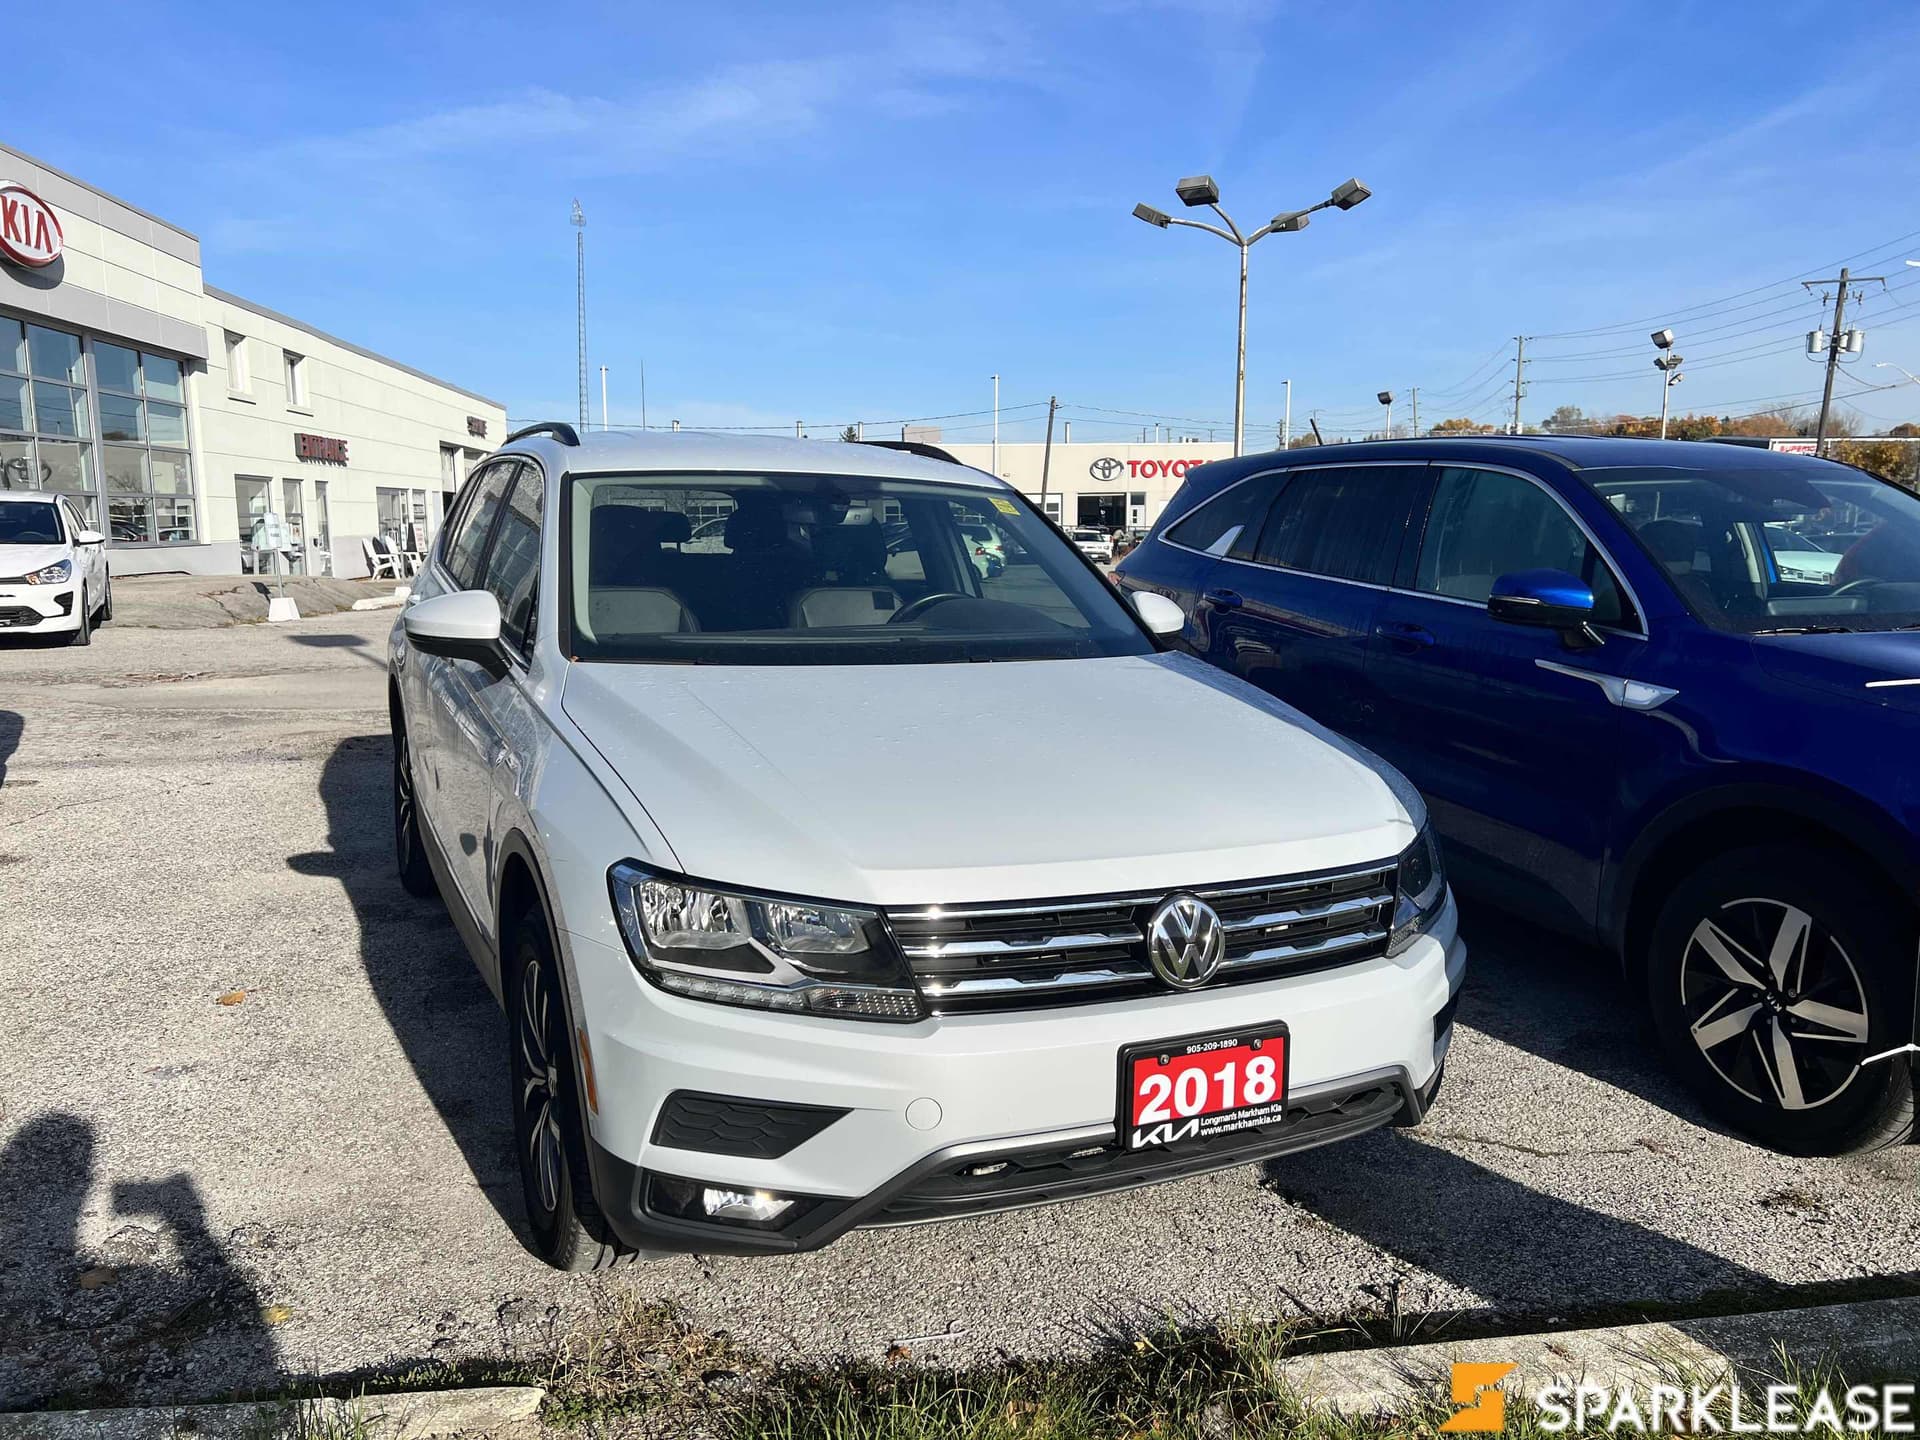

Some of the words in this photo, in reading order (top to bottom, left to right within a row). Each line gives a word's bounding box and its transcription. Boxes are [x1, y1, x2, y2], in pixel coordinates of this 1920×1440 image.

[0, 194, 53, 254] KIA
[1127, 460, 1213, 478] TOYO
[1186, 1039, 1238, 1054] 905-209-1890
[1138, 1056, 1276, 1126] 2018
[1238, 1107, 1270, 1119] Markham
[1270, 1103, 1283, 1113] Kia
[1200, 1114, 1283, 1137] www.markhamkia.ca
